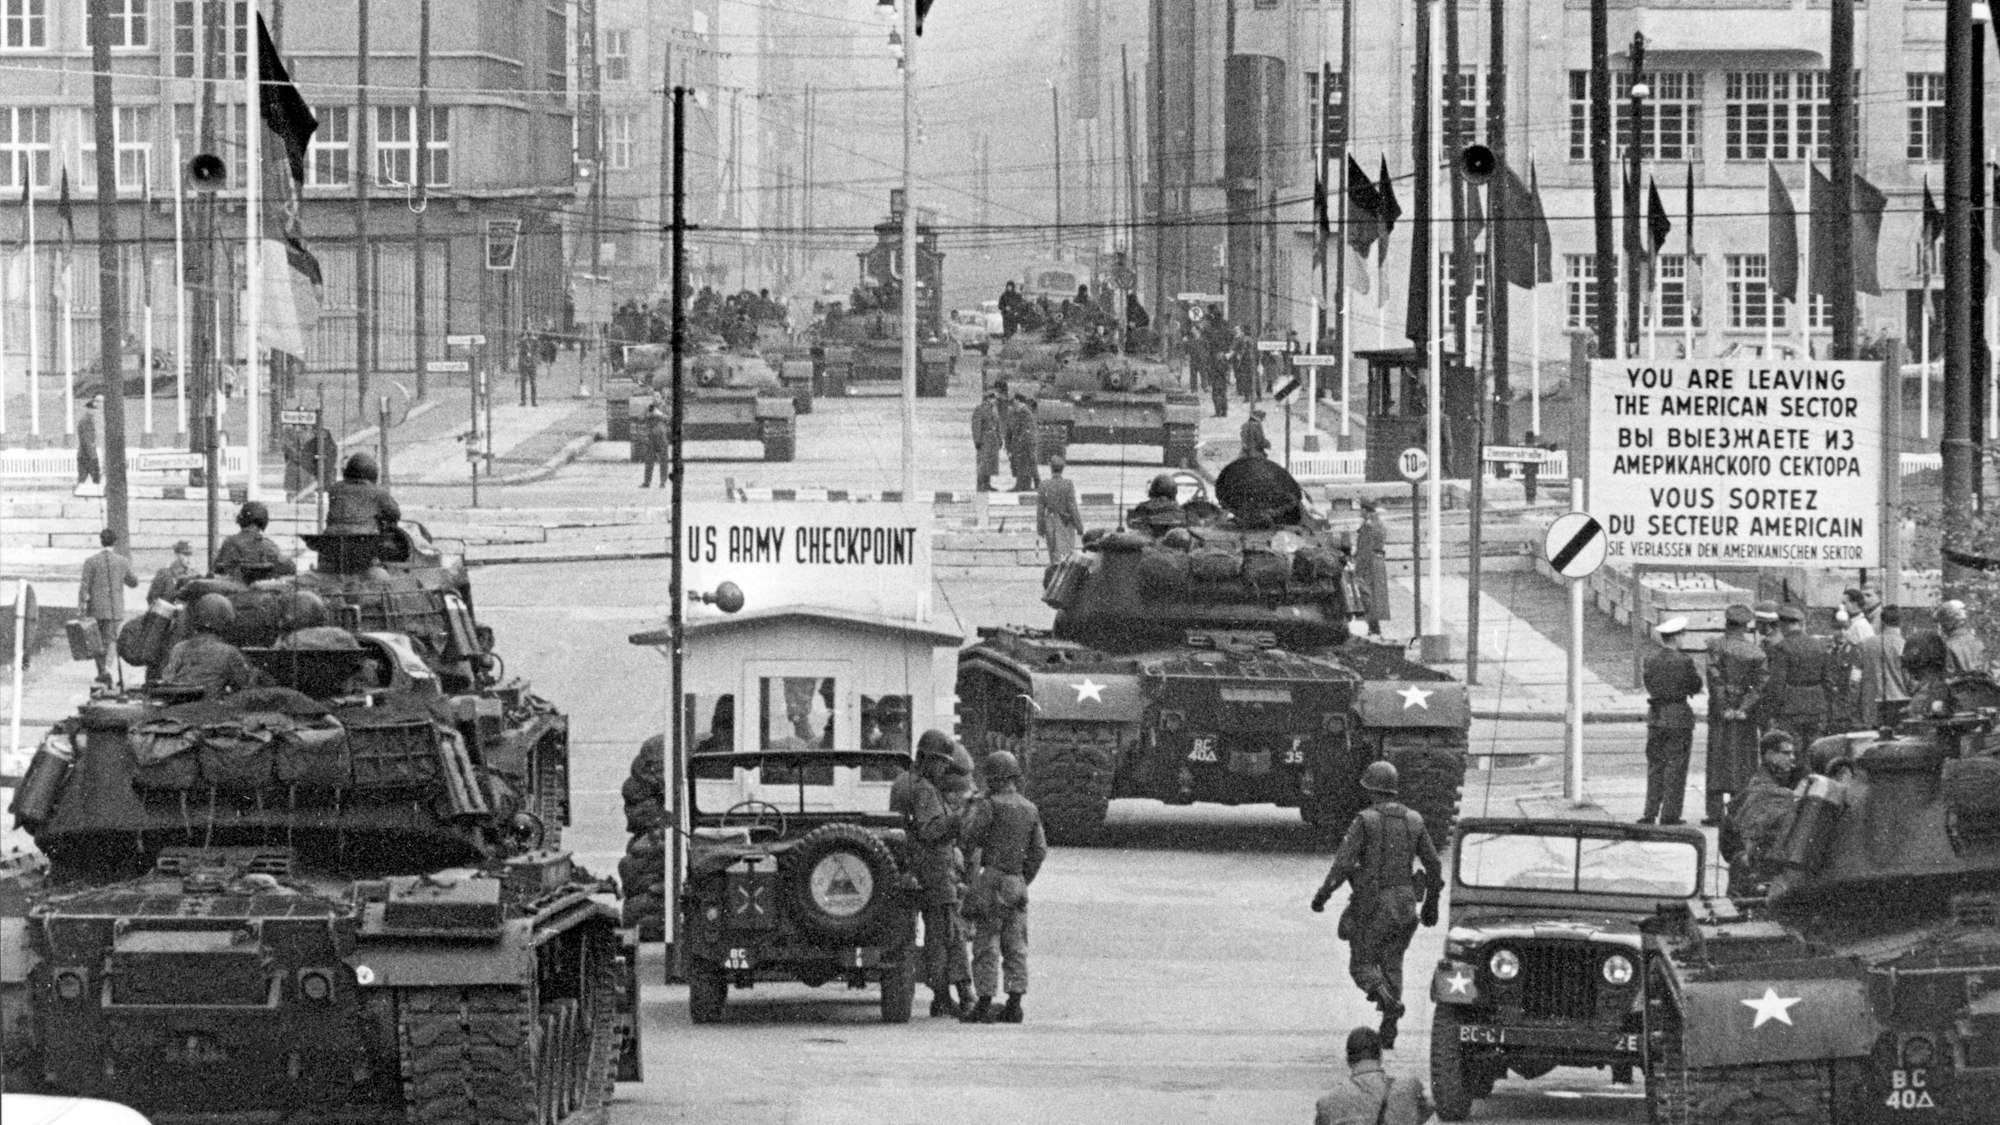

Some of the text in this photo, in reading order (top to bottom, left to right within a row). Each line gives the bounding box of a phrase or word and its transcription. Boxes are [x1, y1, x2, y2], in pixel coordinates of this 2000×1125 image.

[1626, 367, 1845, 391] YOU ARE LEAVING
[1614, 394, 1858, 418] THE AMERICAN SECTOR
[1618, 426, 1854, 451] ВЫ ВЫЕЗЖАЕТЕ ИЗ
[1403, 453, 1418, 472] 10
[1613, 454, 1861, 477] АМЕРИКАНСКОГО СЕКТОРА
[1649, 486, 1818, 511] VOUS SORTEZ
[1609, 514, 1863, 538] DU SECTEUR AMERICAIN
[688, 525, 917, 565] US ARMY CHECKPOINT
[1608, 540, 1863, 560] SIE VERLASSEN DEN AMERIKANISCHEN SEKTOR
[1285, 750, 1304, 764] 35
[1892, 1069, 1926, 1092] BC
[1885, 1089, 1917, 1109] 40
